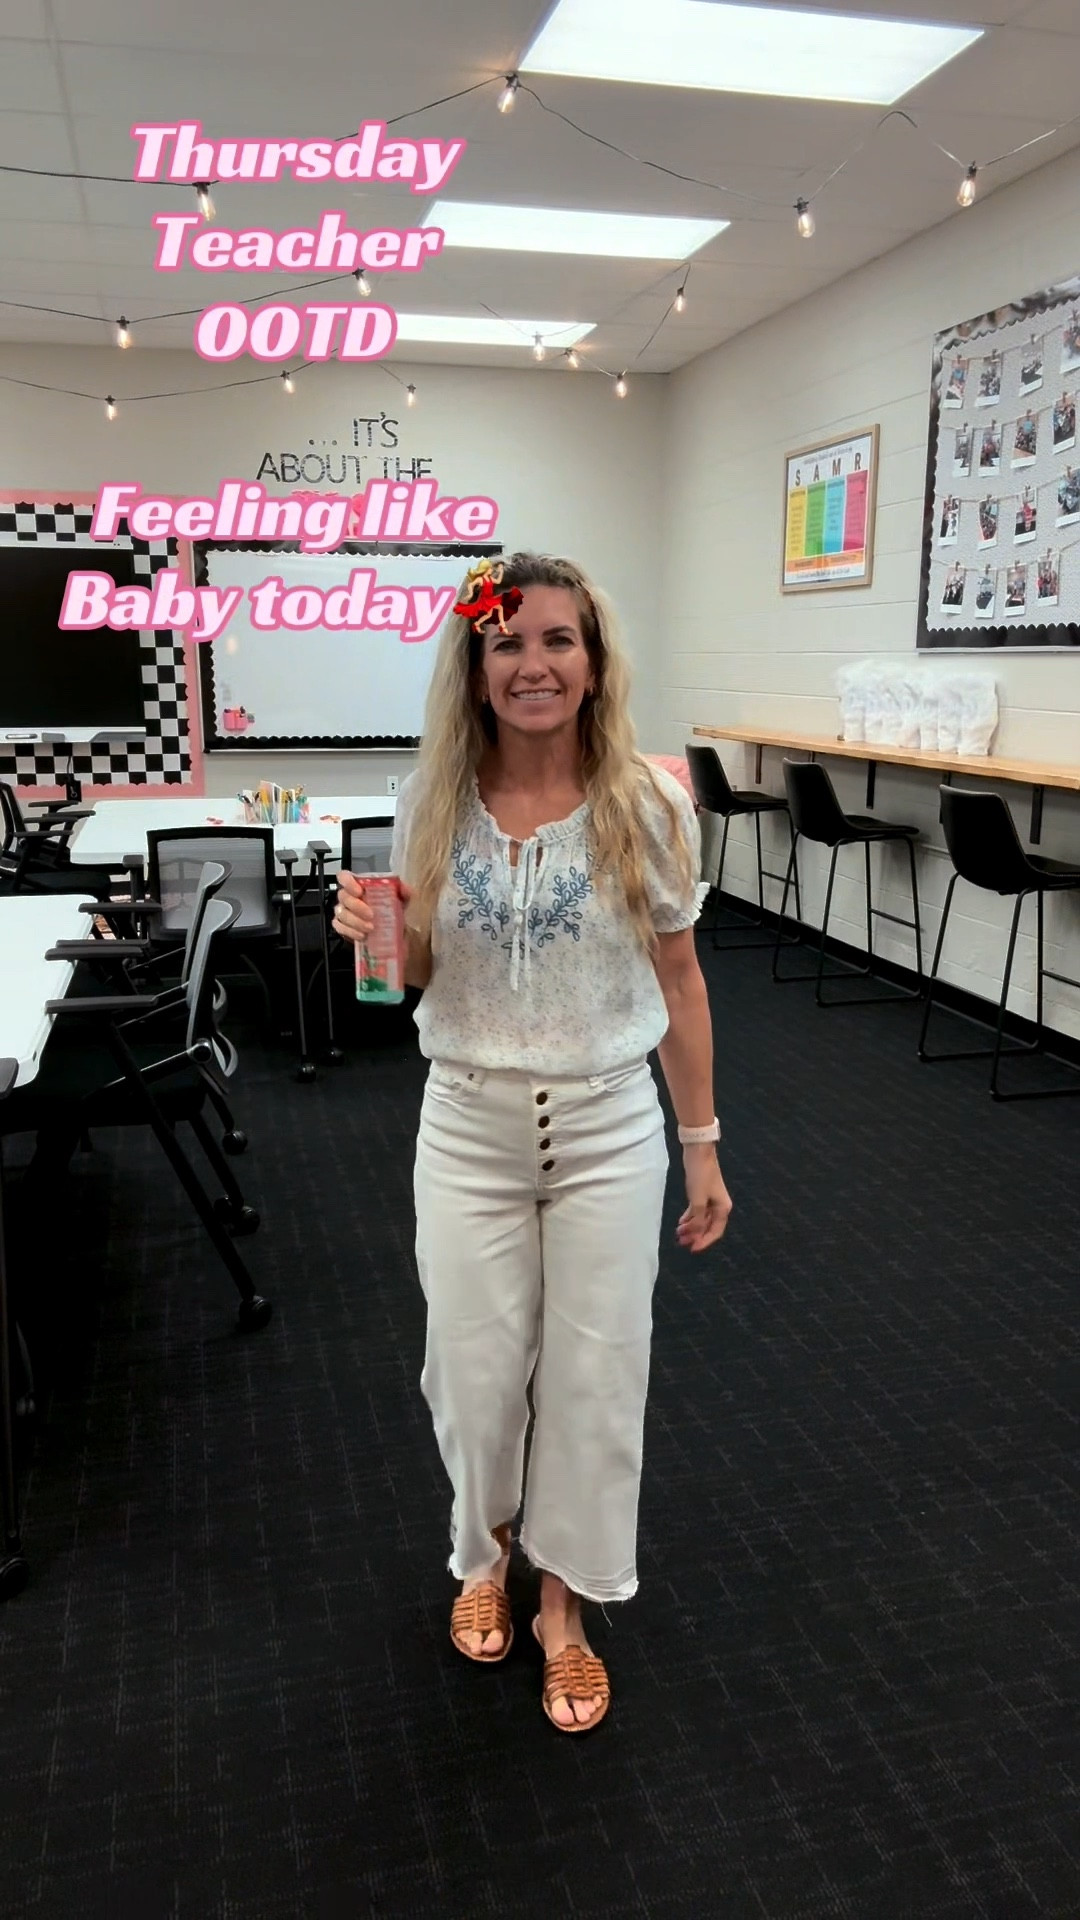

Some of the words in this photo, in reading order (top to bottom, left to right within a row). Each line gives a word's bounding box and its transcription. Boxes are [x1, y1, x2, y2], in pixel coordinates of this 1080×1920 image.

[352, 411, 399, 449] IT'S
[256, 452, 368, 484] ABOUT
[376, 456, 433, 484] THE
